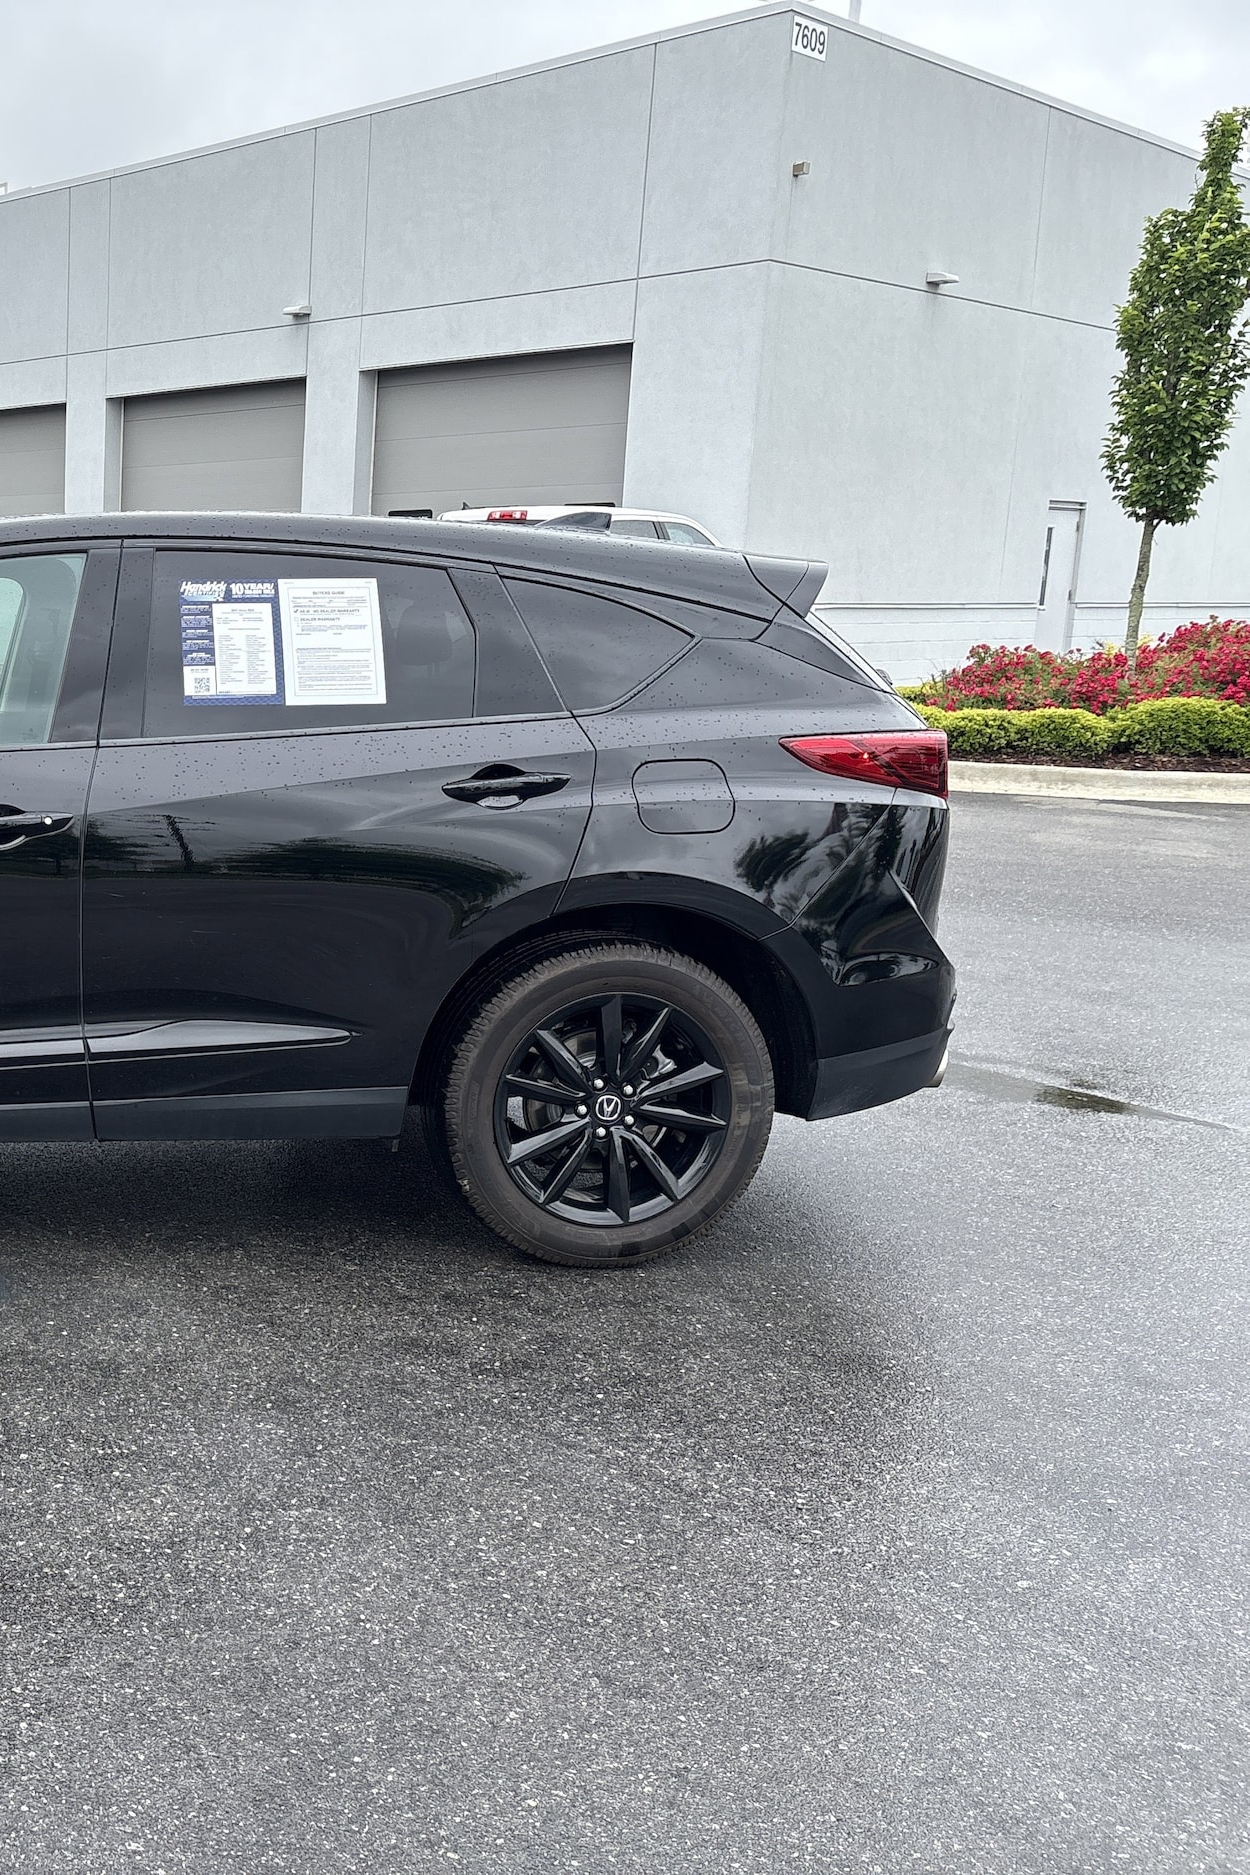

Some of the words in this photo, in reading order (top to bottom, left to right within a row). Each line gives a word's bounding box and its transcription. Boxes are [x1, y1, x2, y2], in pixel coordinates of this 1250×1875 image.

[795, 22, 826, 55] 7609
[180, 581, 227, 595] Hendrick
[230, 583, 244, 595] 10
